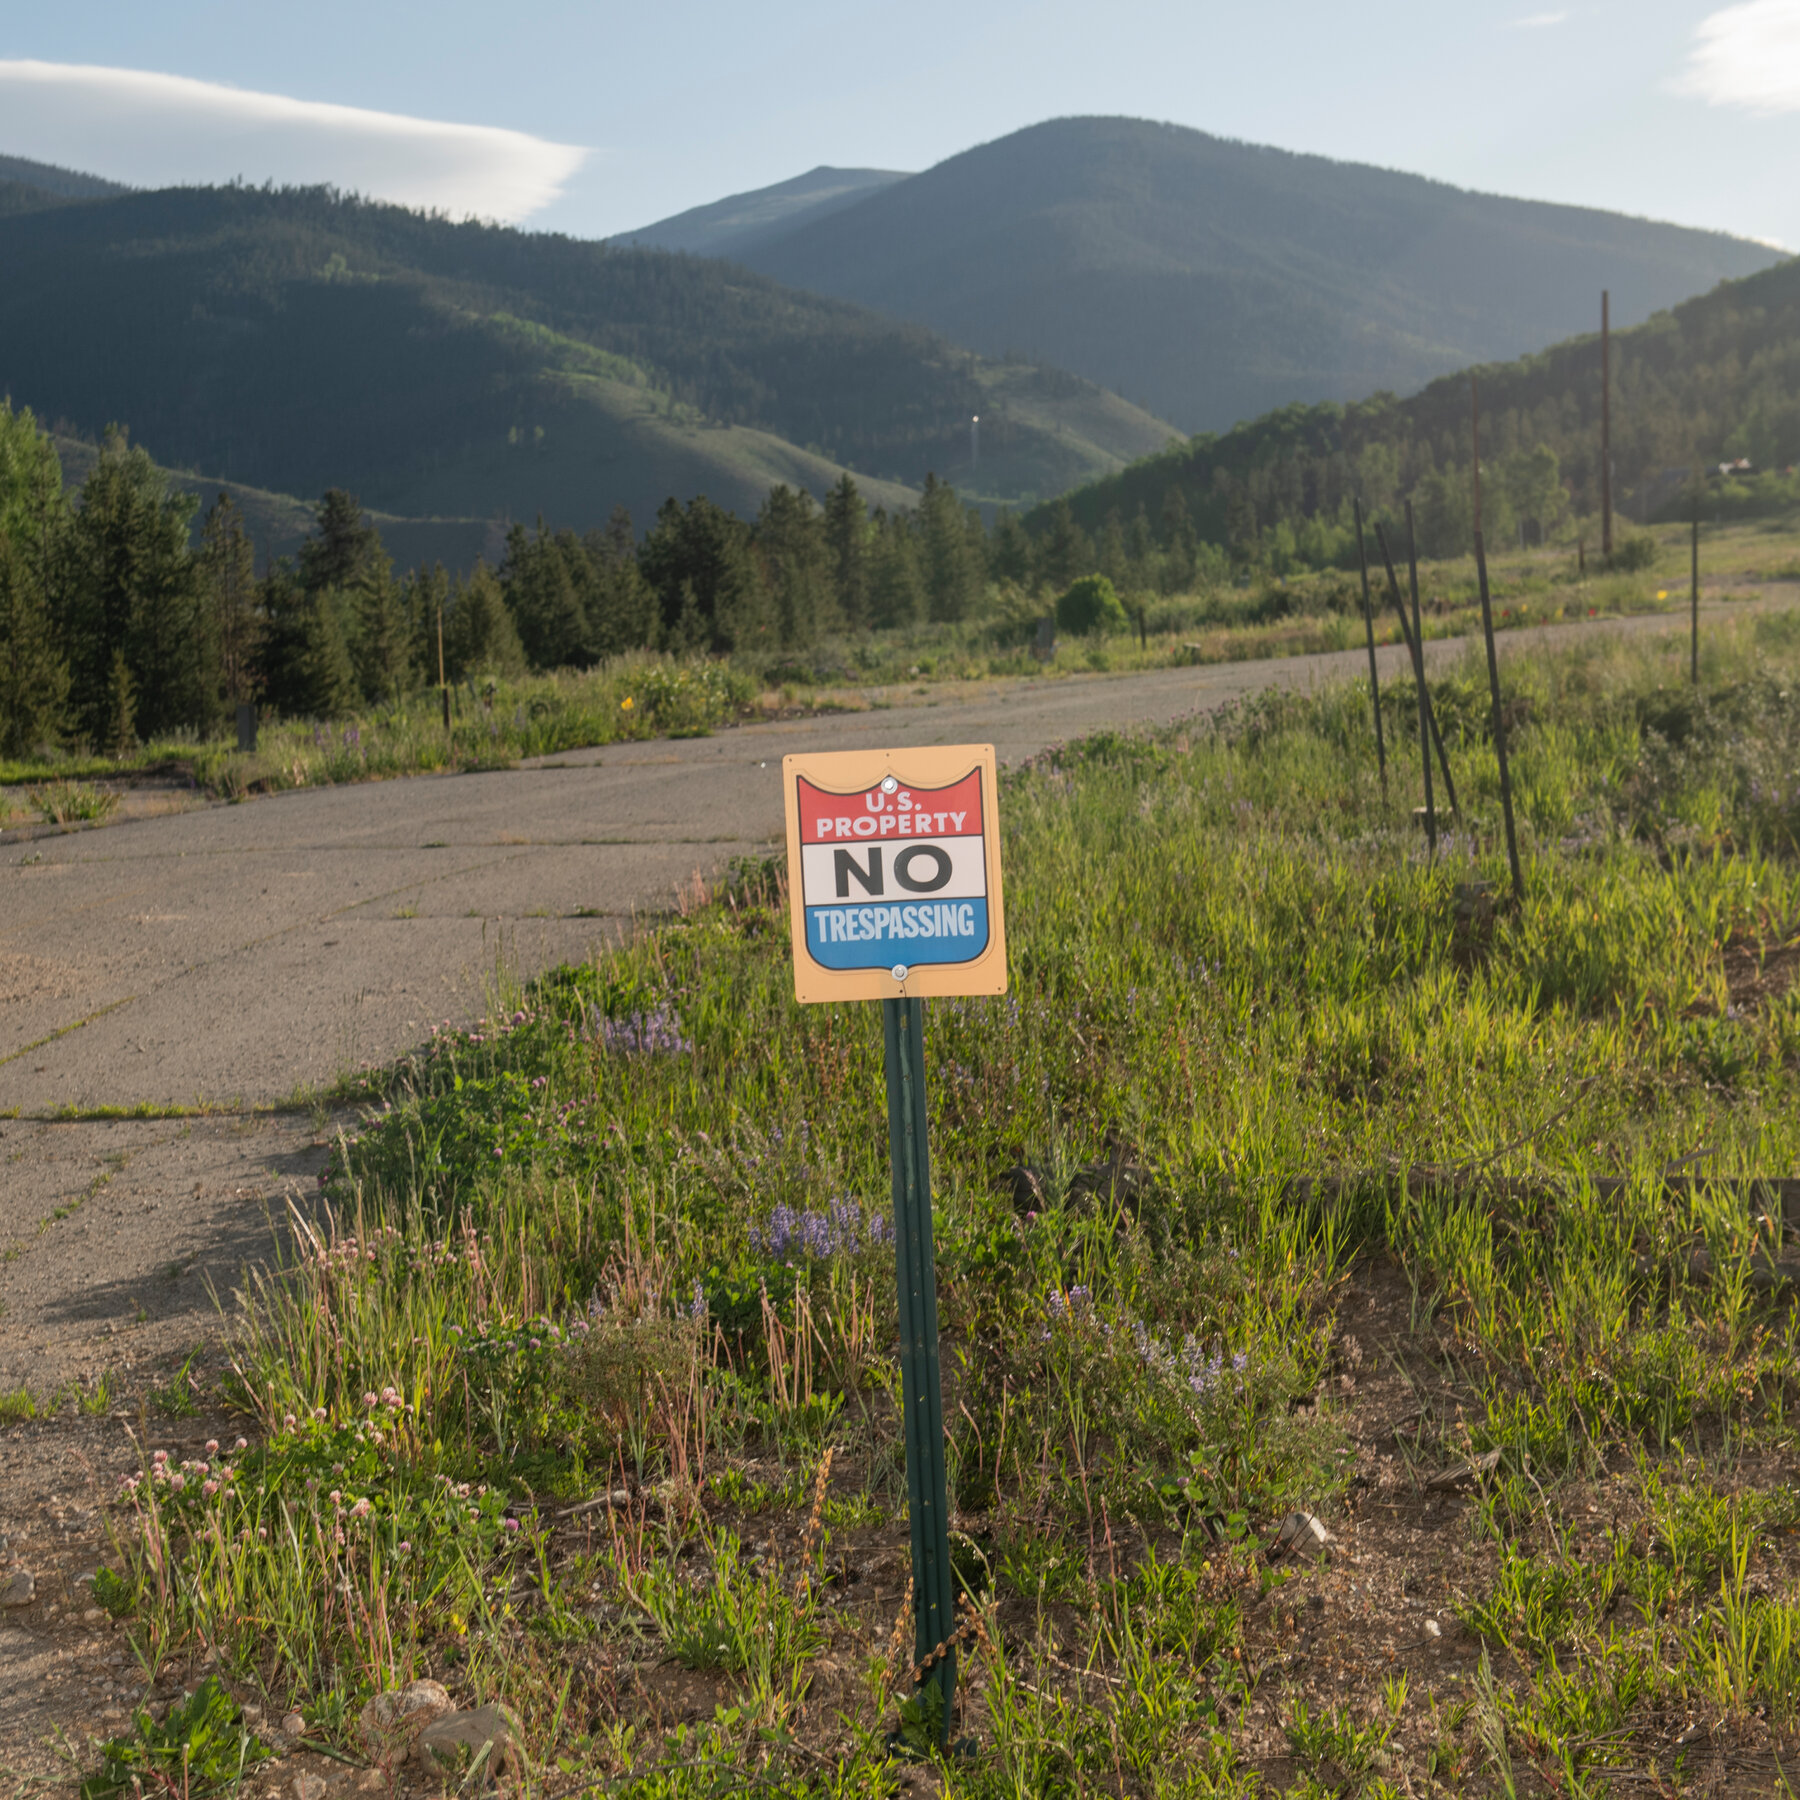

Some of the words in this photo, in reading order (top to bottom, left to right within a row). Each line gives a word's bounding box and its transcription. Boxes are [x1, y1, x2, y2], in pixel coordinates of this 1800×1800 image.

[866, 792, 922, 812] U.S.
[817, 812, 967, 838] PROPERTY
[833, 844, 953, 897] NO
[814, 903, 975, 943] TRESPASSING
